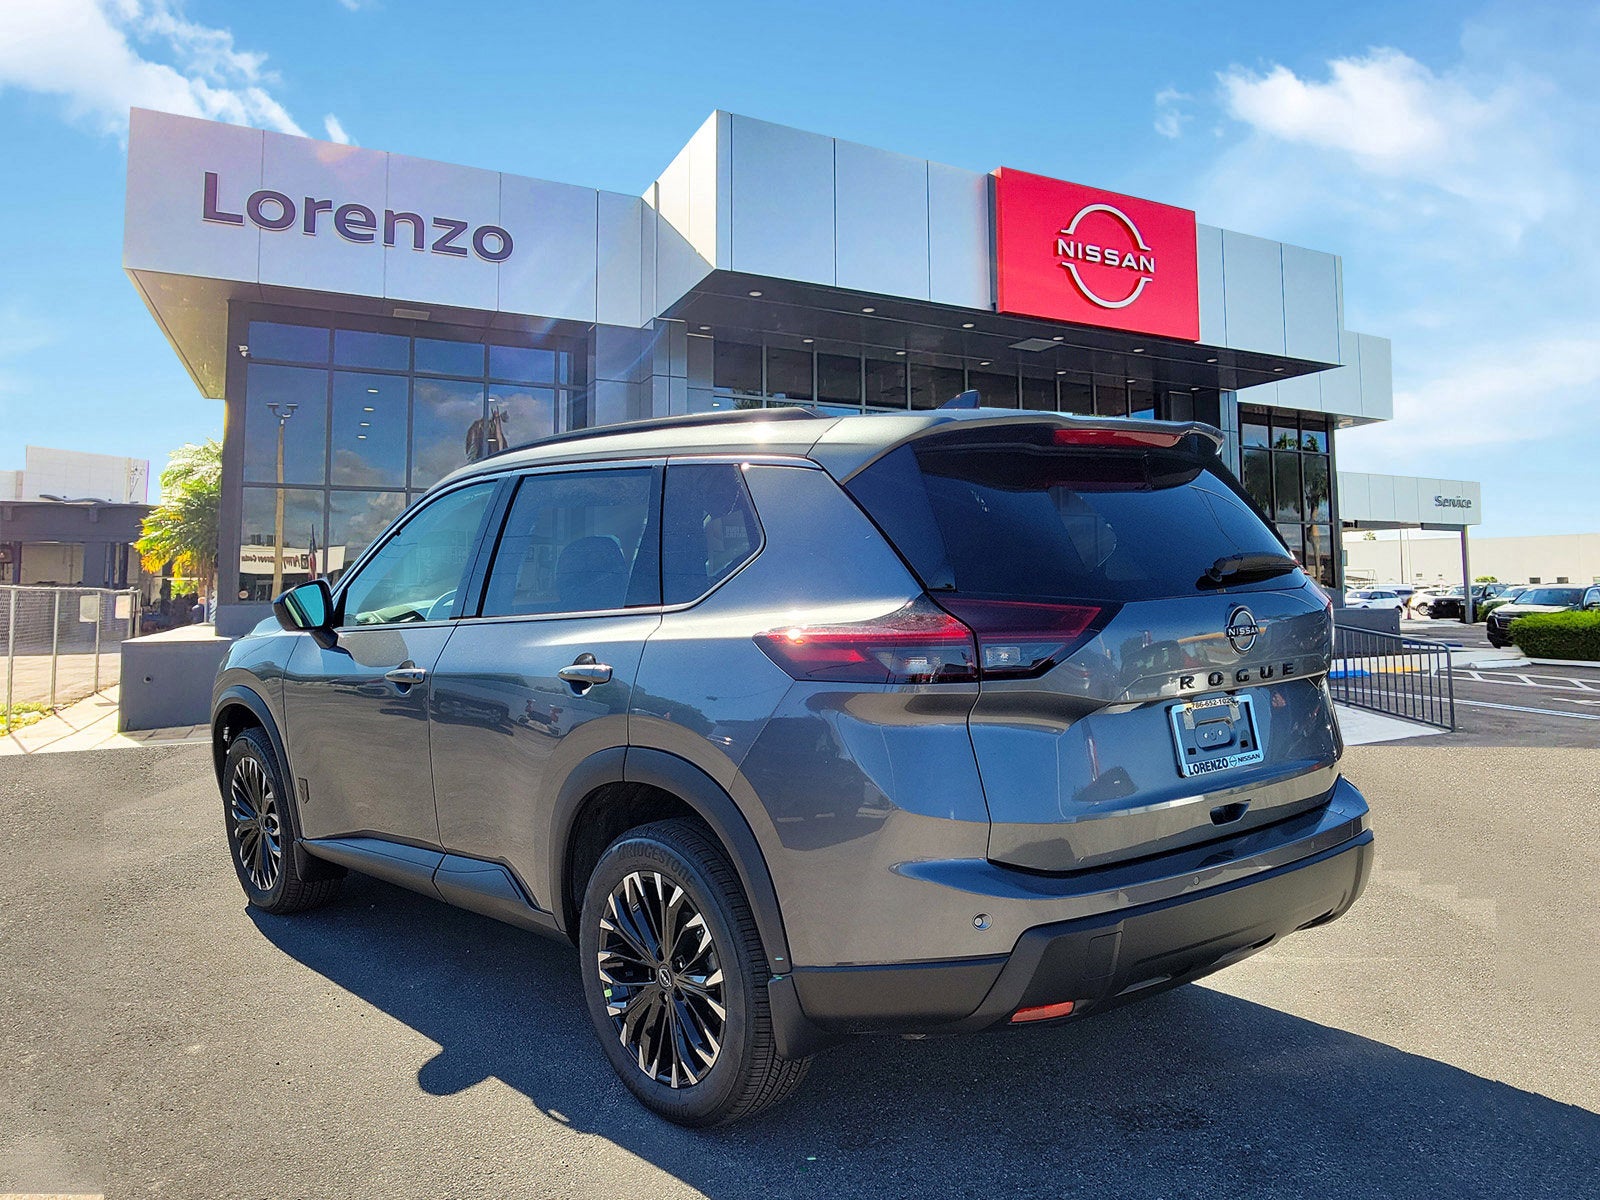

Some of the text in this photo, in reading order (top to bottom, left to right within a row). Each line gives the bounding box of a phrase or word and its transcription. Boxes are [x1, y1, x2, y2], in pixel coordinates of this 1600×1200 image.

[202, 171, 514, 262] Lorenzo
[1057, 238, 1155, 274] NISSAN
[1434, 495, 1472, 509] Service
[1227, 625, 1260, 637] NISSAN
[1179, 662, 1294, 690] ROGUE
[1188, 752, 1261, 776] LORENZO NISSAN
[618, 841, 697, 888] BRIDGESTONE
